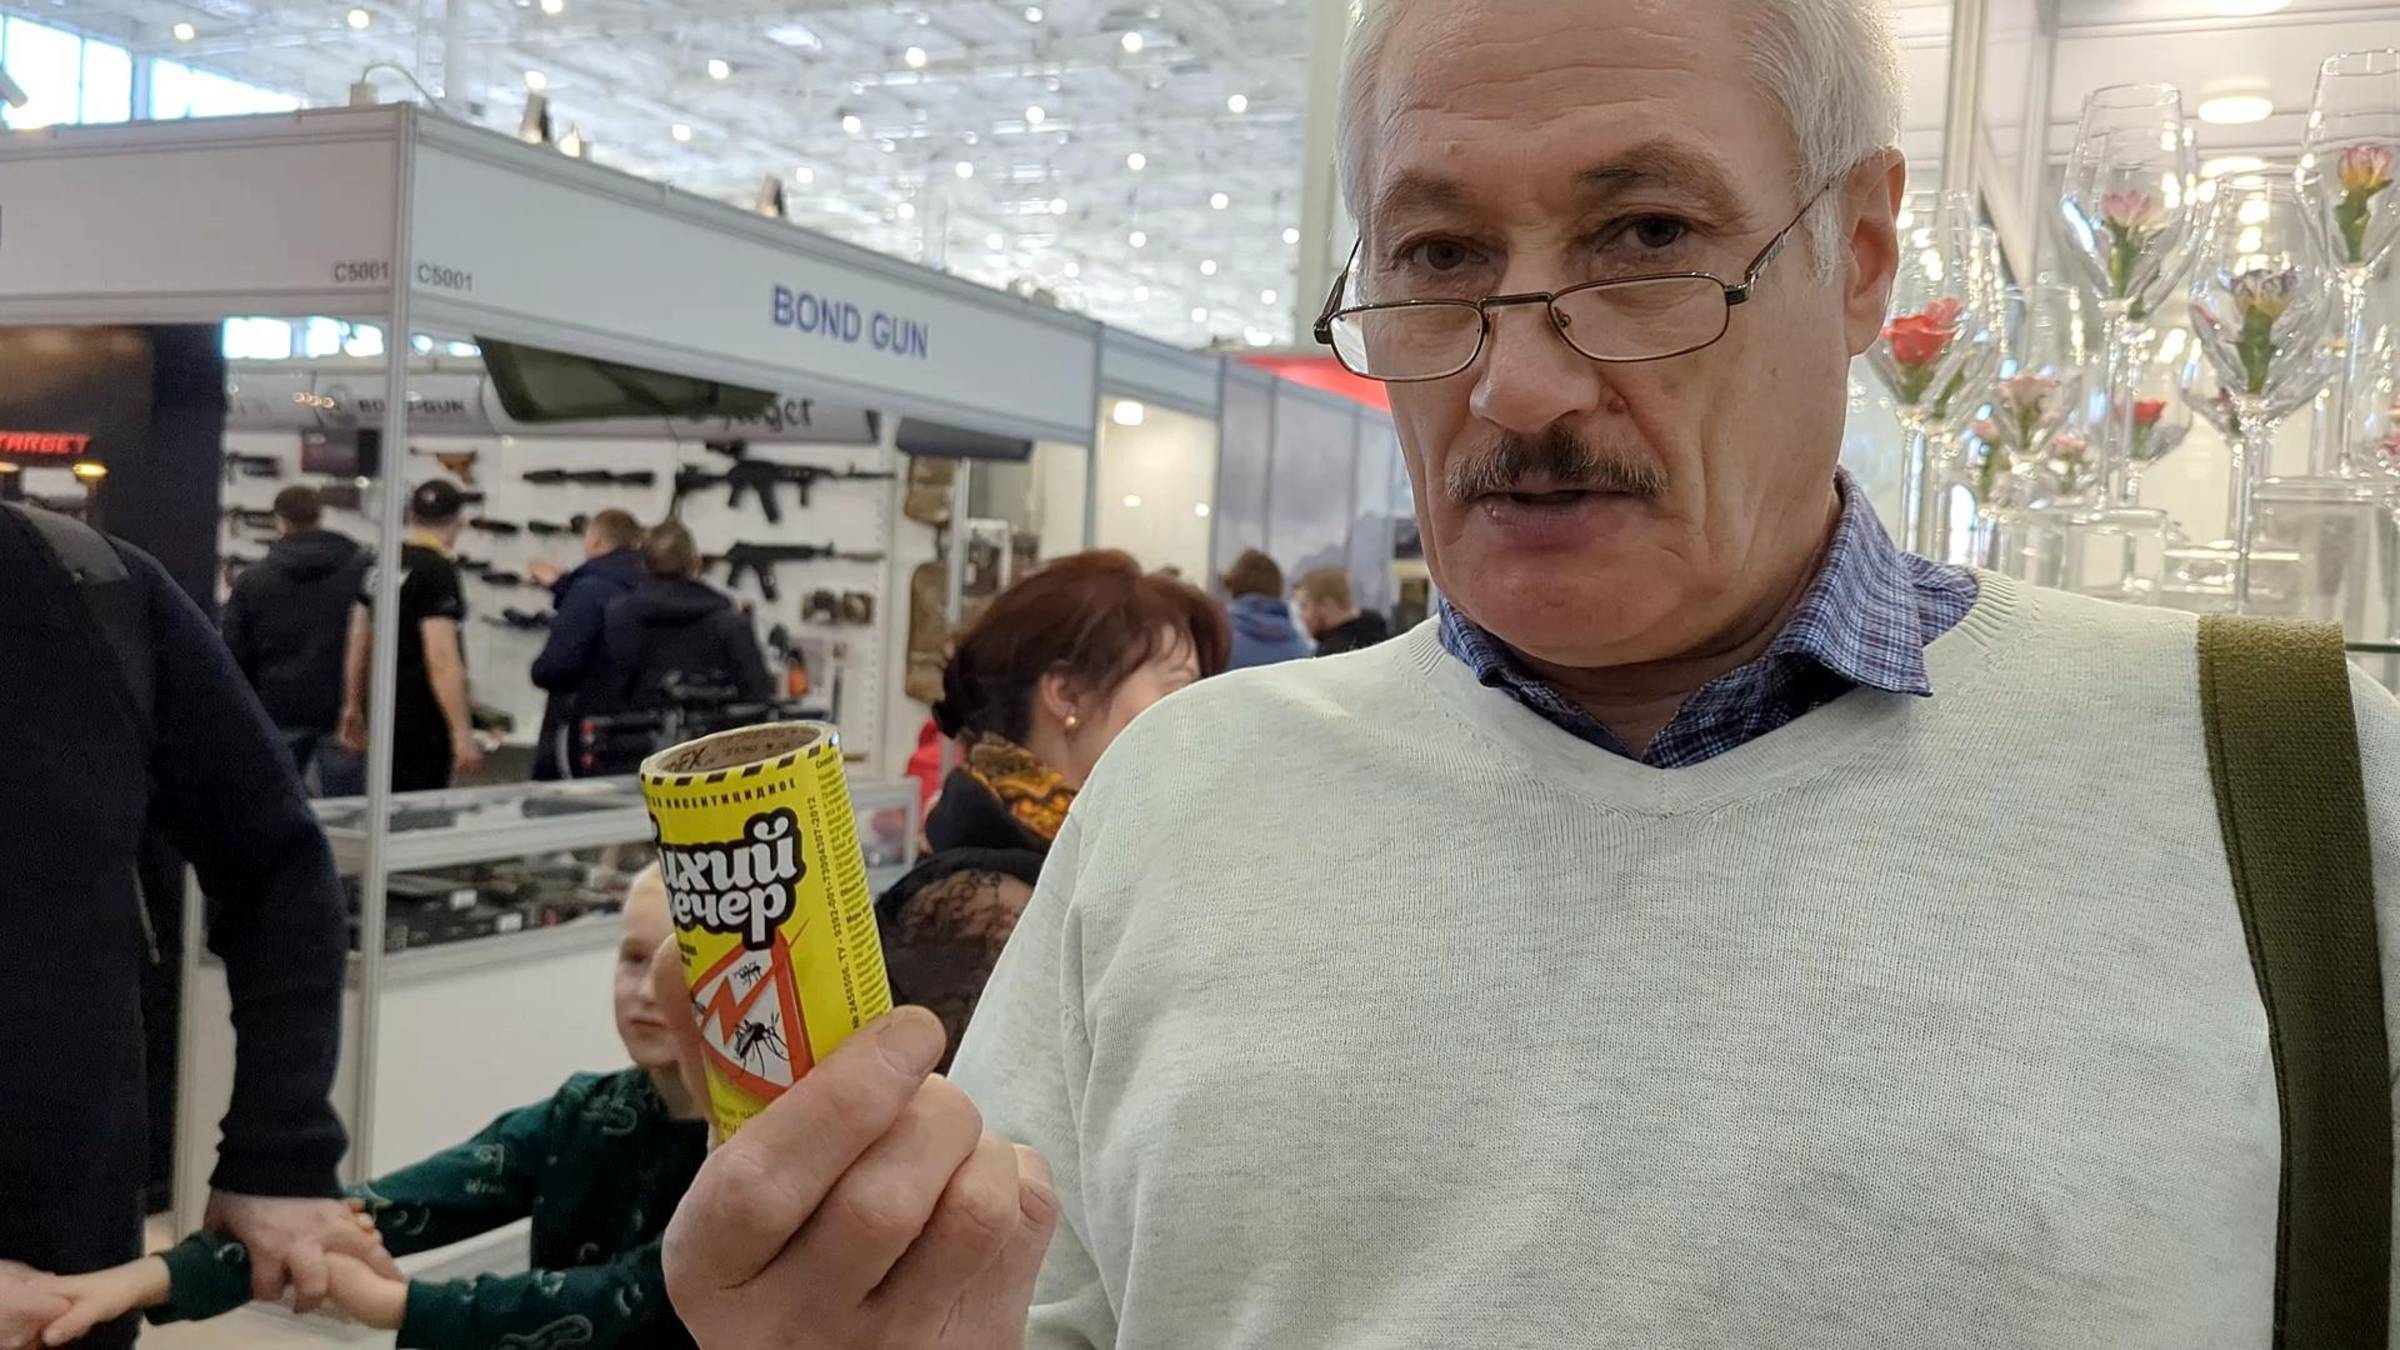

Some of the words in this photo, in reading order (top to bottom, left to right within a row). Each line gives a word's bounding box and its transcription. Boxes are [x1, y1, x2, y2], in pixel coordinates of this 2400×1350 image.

[334, 260, 389, 283] C5001
[418, 263, 473, 291] C5001
[773, 284, 862, 343] BOND
[871, 311, 929, 359] GUN
[649, 815, 797, 891] ихий
[668, 882, 787, 943] ечер
